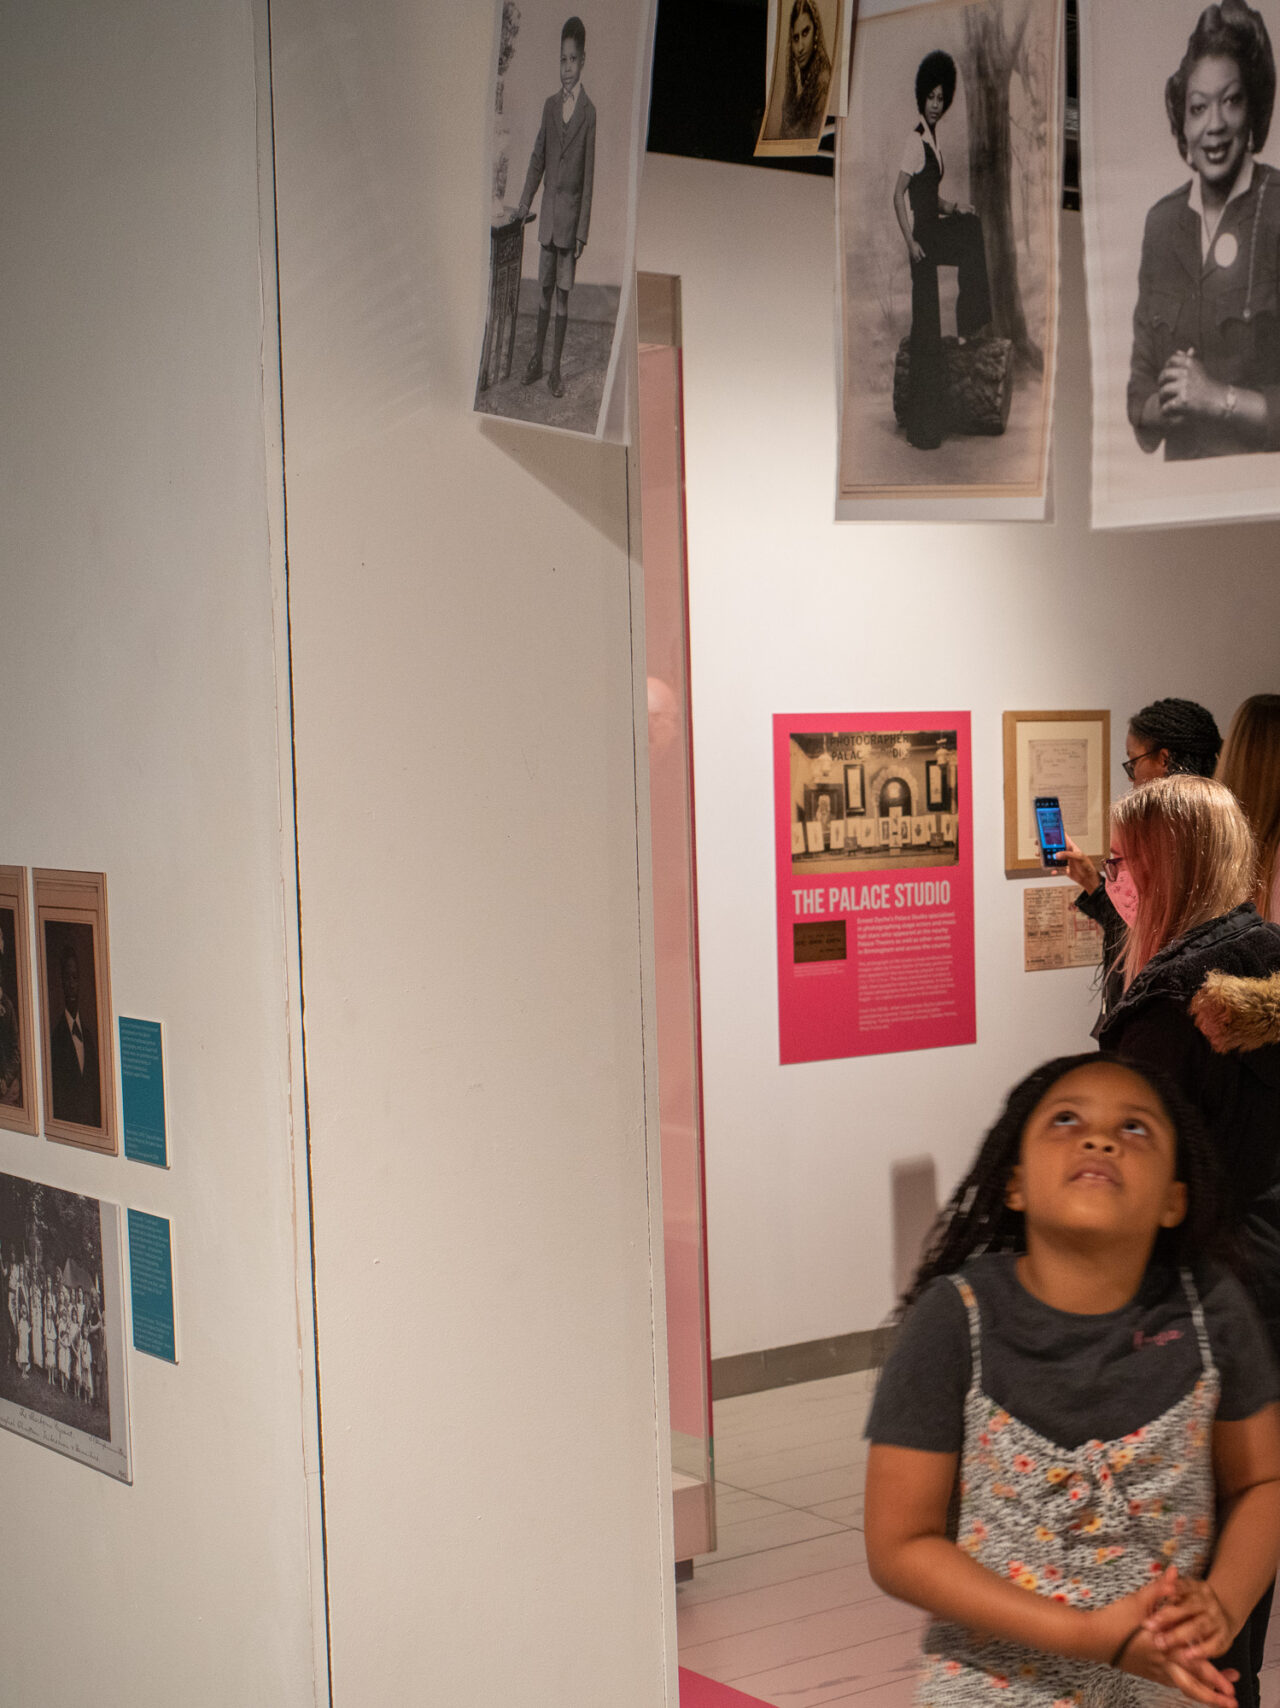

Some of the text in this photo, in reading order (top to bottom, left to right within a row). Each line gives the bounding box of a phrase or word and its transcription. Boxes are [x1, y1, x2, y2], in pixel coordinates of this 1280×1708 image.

[831, 733, 909, 746] PHOTOGRAPHER
[831, 750, 863, 761] PALAC
[792, 880, 950, 915] THE PALACE STUDIO
